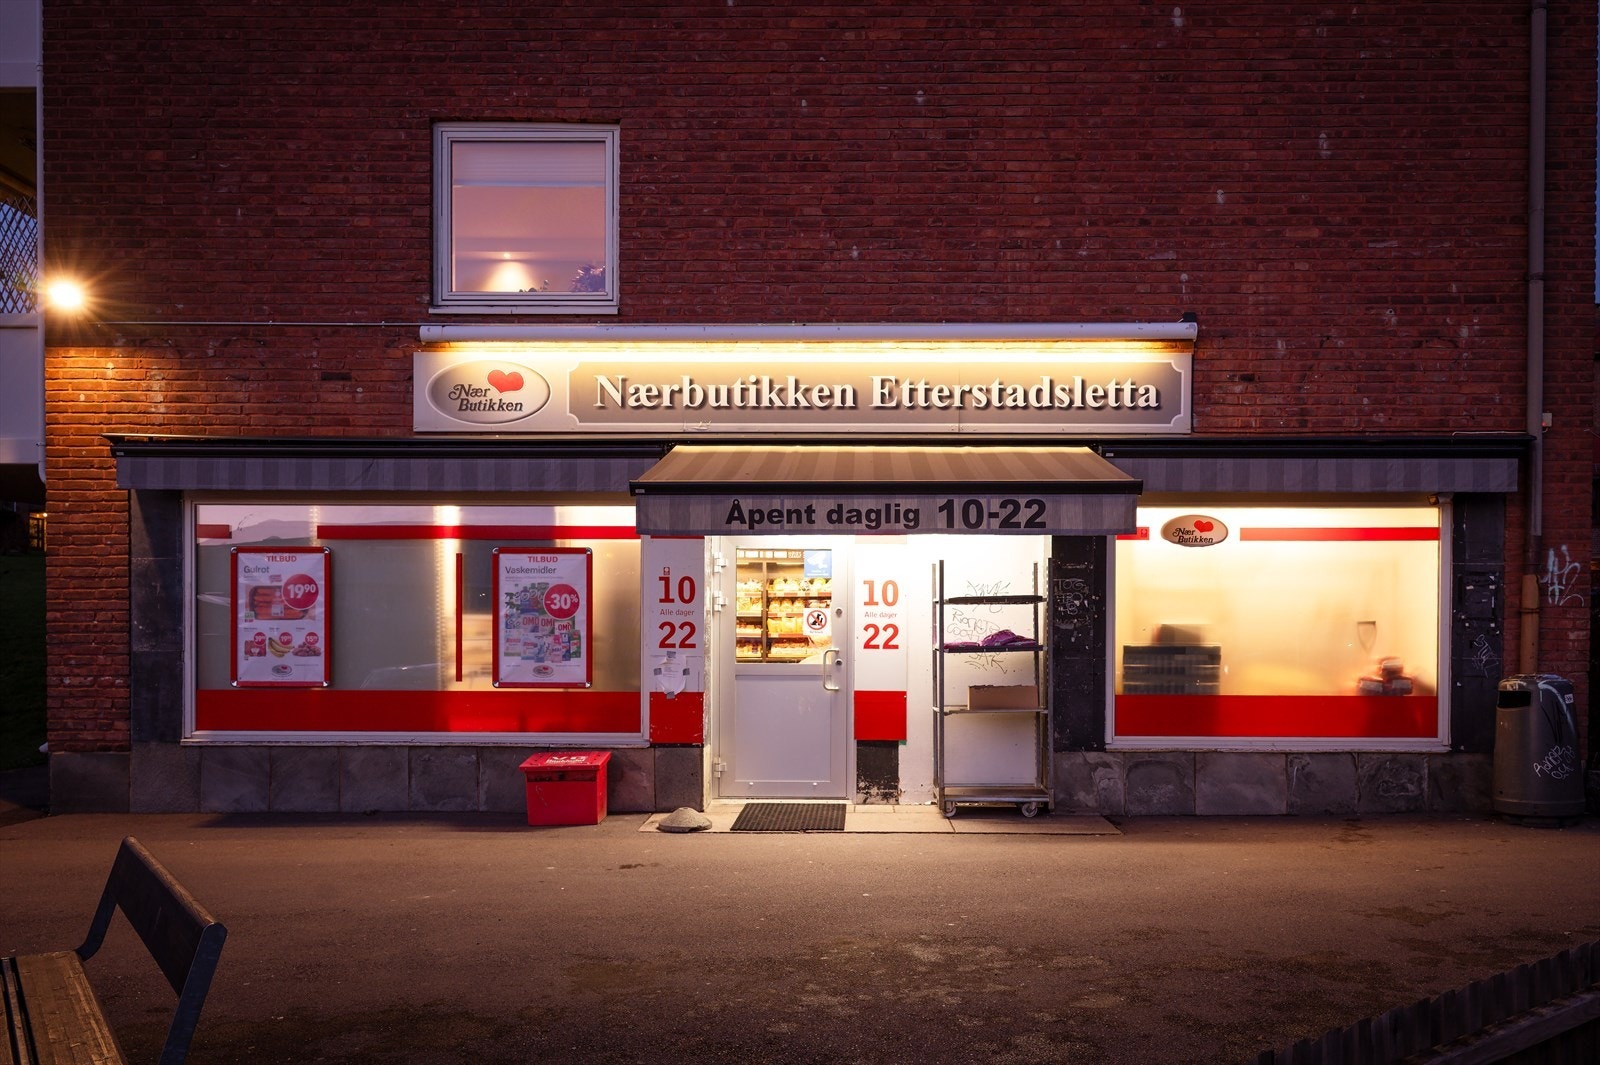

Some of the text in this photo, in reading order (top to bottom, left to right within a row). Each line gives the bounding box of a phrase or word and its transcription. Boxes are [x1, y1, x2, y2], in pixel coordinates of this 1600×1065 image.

[449, 382, 491, 401] Nær
[594, 373, 1160, 409] Nærbutikken Etterstadsletta
[458, 397, 523, 413] Butikken
[726, 497, 1047, 530] Åpent daglig 10-22
[1172, 527, 1196, 538] Nær
[1178, 535, 1213, 543] Butikken
[243, 565, 270, 573] Gulrot
[504, 566, 557, 574] Vaskemidler
[658, 575, 696, 604] 10
[863, 580, 899, 607] 10
[546, 593, 579, 610] -30%
[659, 608, 695, 617] Alle dager
[879, 611, 897, 619] dager
[522, 617, 539, 626] OMO
[658, 621, 697, 649] 22
[863, 623, 900, 650] 22
